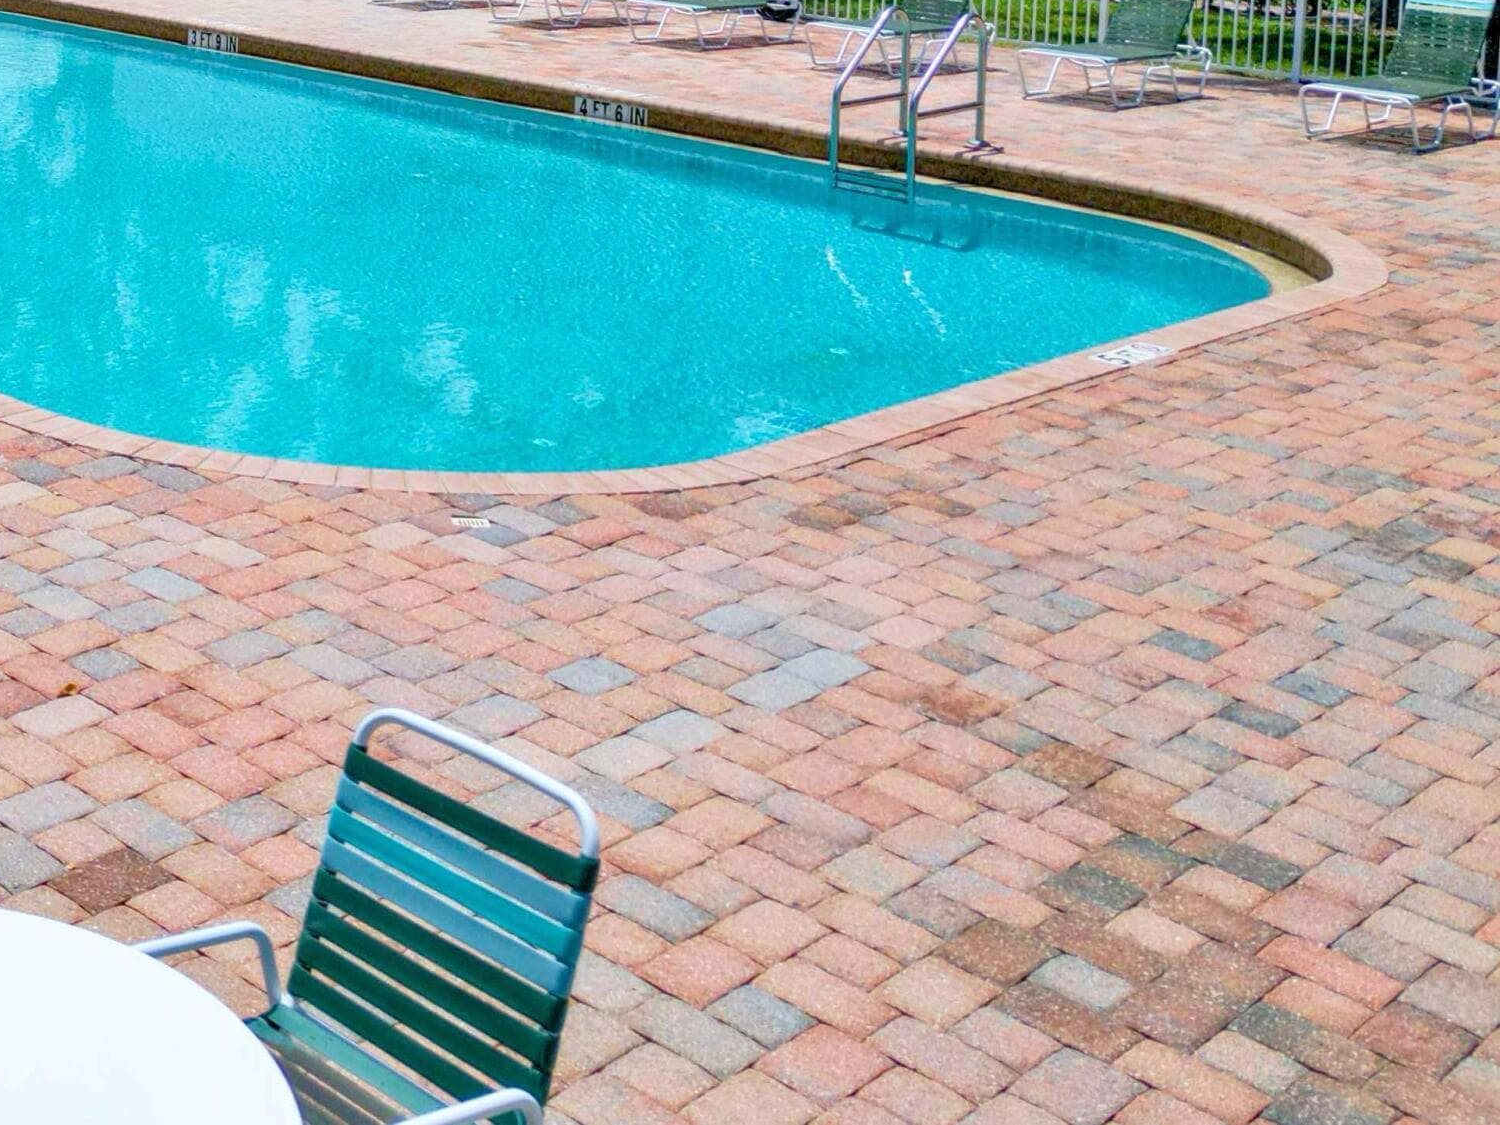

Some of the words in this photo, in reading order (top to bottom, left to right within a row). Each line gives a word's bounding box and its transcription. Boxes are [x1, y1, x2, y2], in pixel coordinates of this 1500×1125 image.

[191, 29, 197, 45] 3
[200, 31, 212, 49] FT
[215, 34, 222, 50] 9
[226, 35, 237, 53] IN
[580, 98, 588, 116] 4
[593, 100, 610, 116] FT
[615, 104, 623, 122] 6
[629, 106, 645, 125] IN
